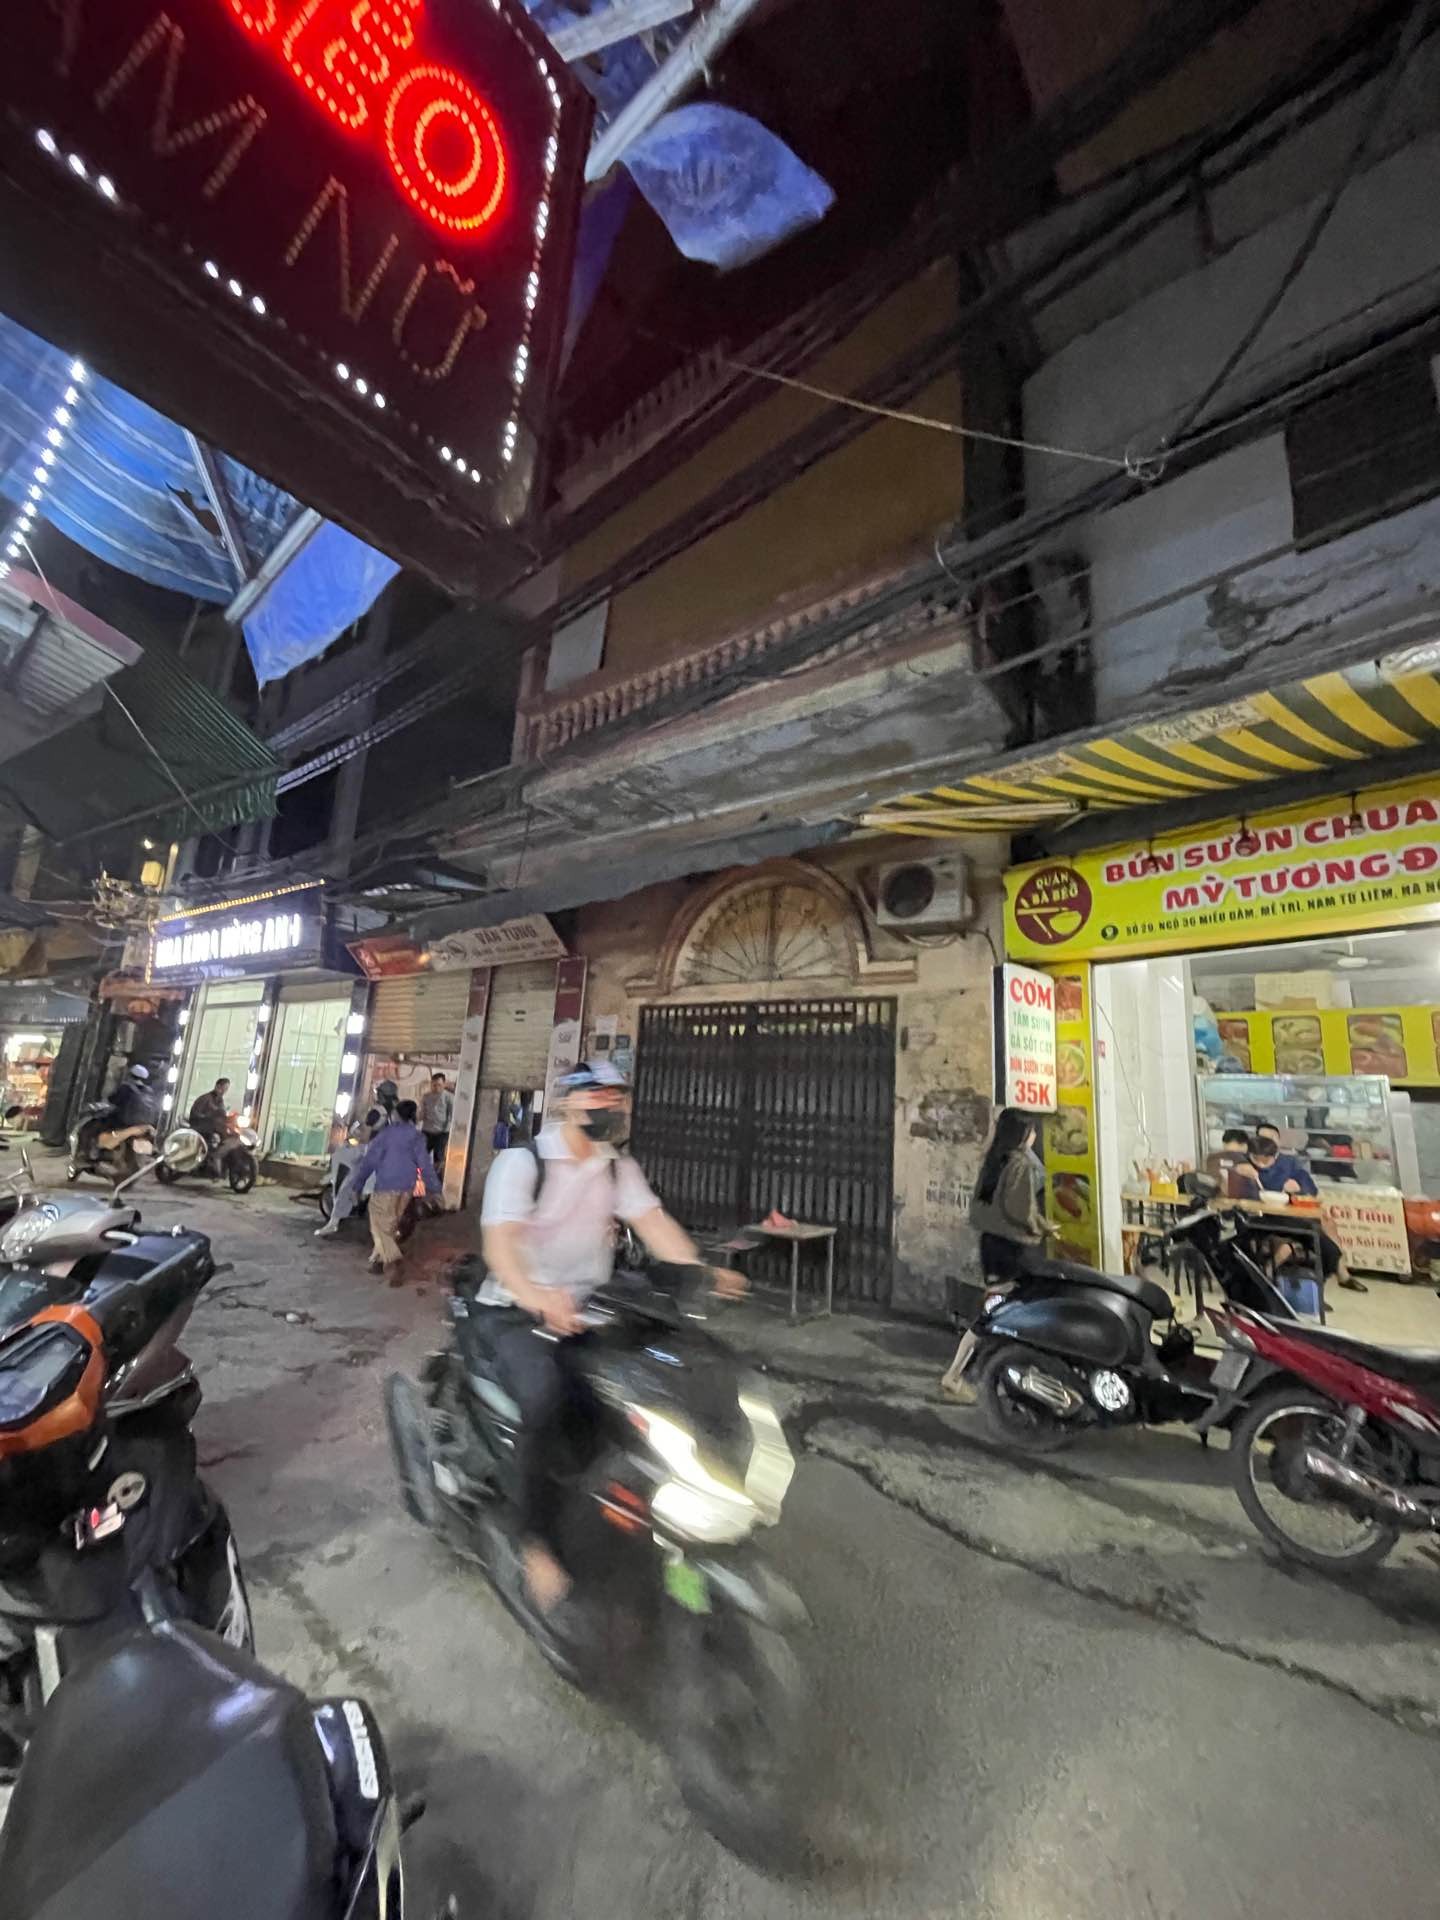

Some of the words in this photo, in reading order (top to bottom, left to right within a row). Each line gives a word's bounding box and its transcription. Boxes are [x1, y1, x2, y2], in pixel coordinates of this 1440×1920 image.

[1303, 799, 1438, 846] CHUA
[1165, 876, 1224, 911] MỲ
[1009, 976, 1052, 1011] CƠM
[1014, 1078, 1051, 1107] 35K
